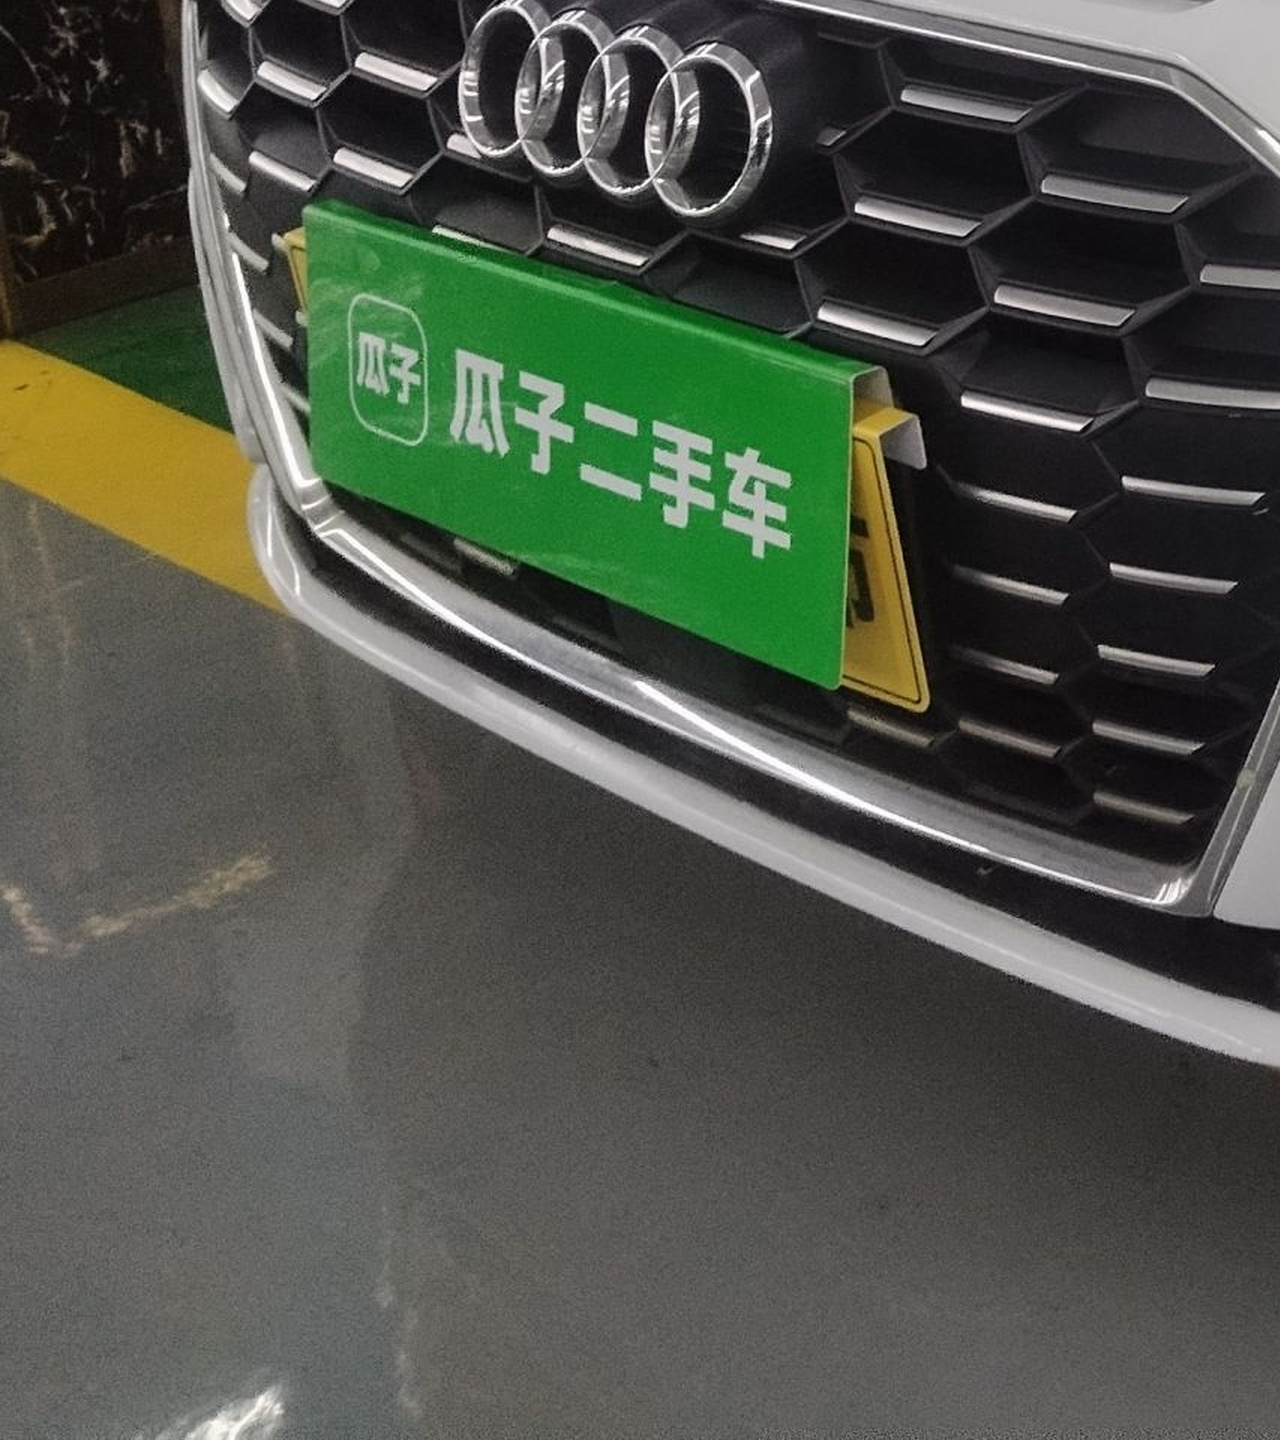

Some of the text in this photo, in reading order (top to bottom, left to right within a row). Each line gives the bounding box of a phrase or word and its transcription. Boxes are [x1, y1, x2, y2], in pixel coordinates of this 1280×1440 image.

[357, 331, 421, 404] 瓜子
[450, 348, 792, 559] 瓜子二手车
